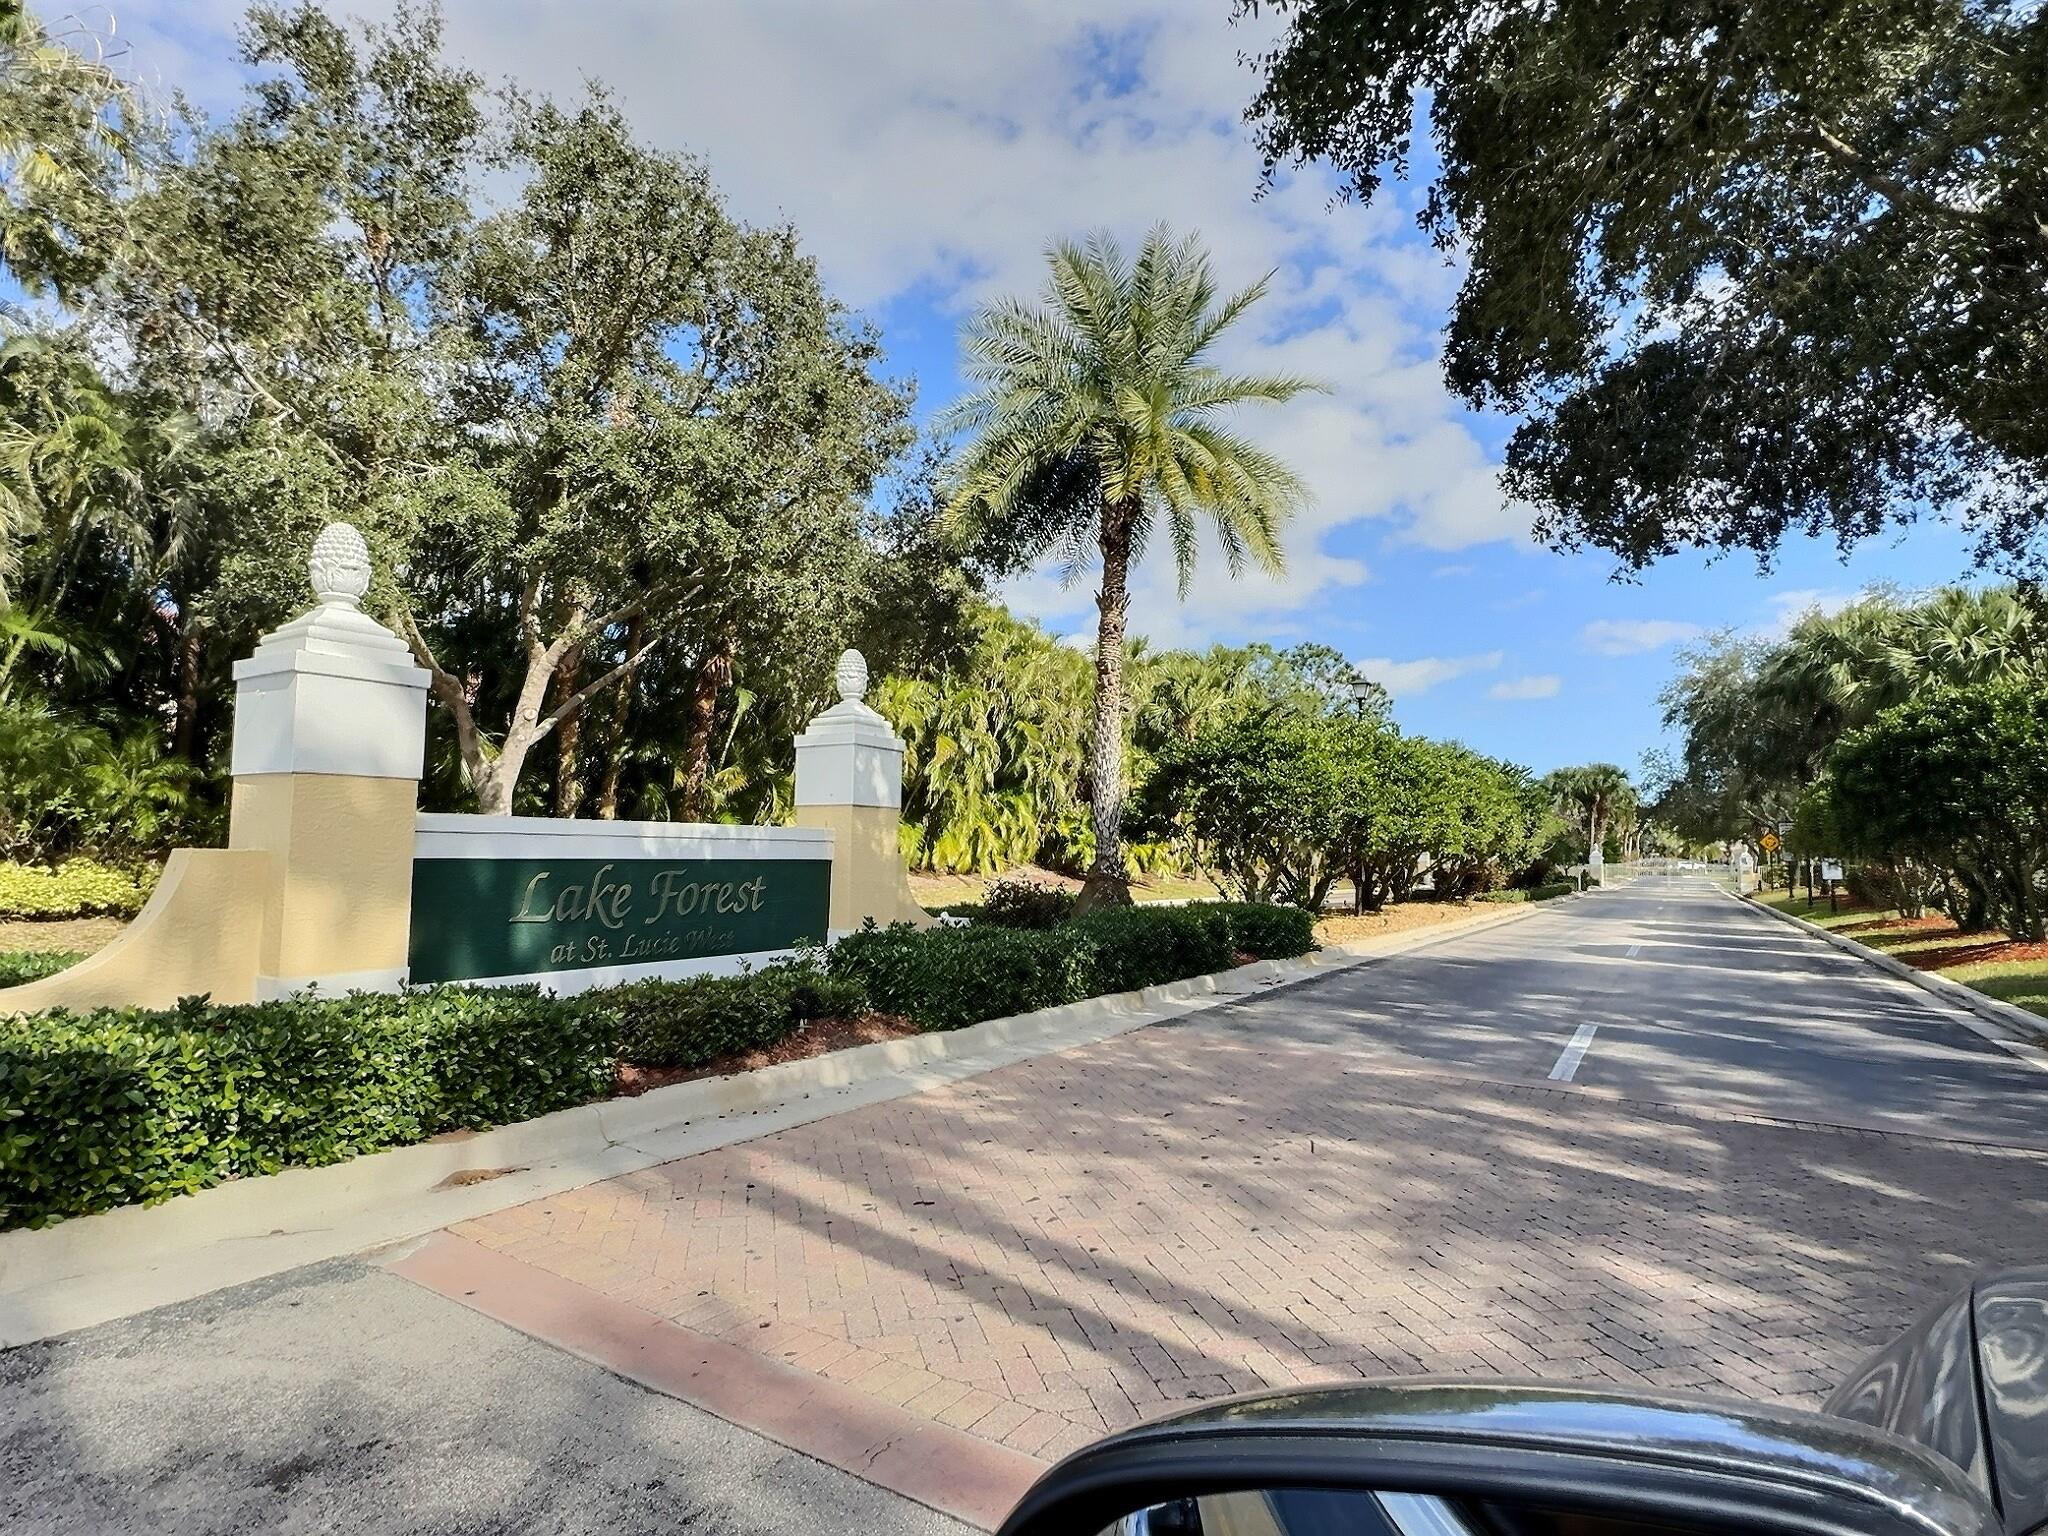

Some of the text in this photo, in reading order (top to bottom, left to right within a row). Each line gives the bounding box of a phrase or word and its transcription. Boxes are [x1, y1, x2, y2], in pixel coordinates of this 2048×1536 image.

[508, 863, 767, 929] Lake Forest
[551, 941, 576, 964] at
[580, 935, 613, 963] St.
[619, 930, 681, 958] Lucie
